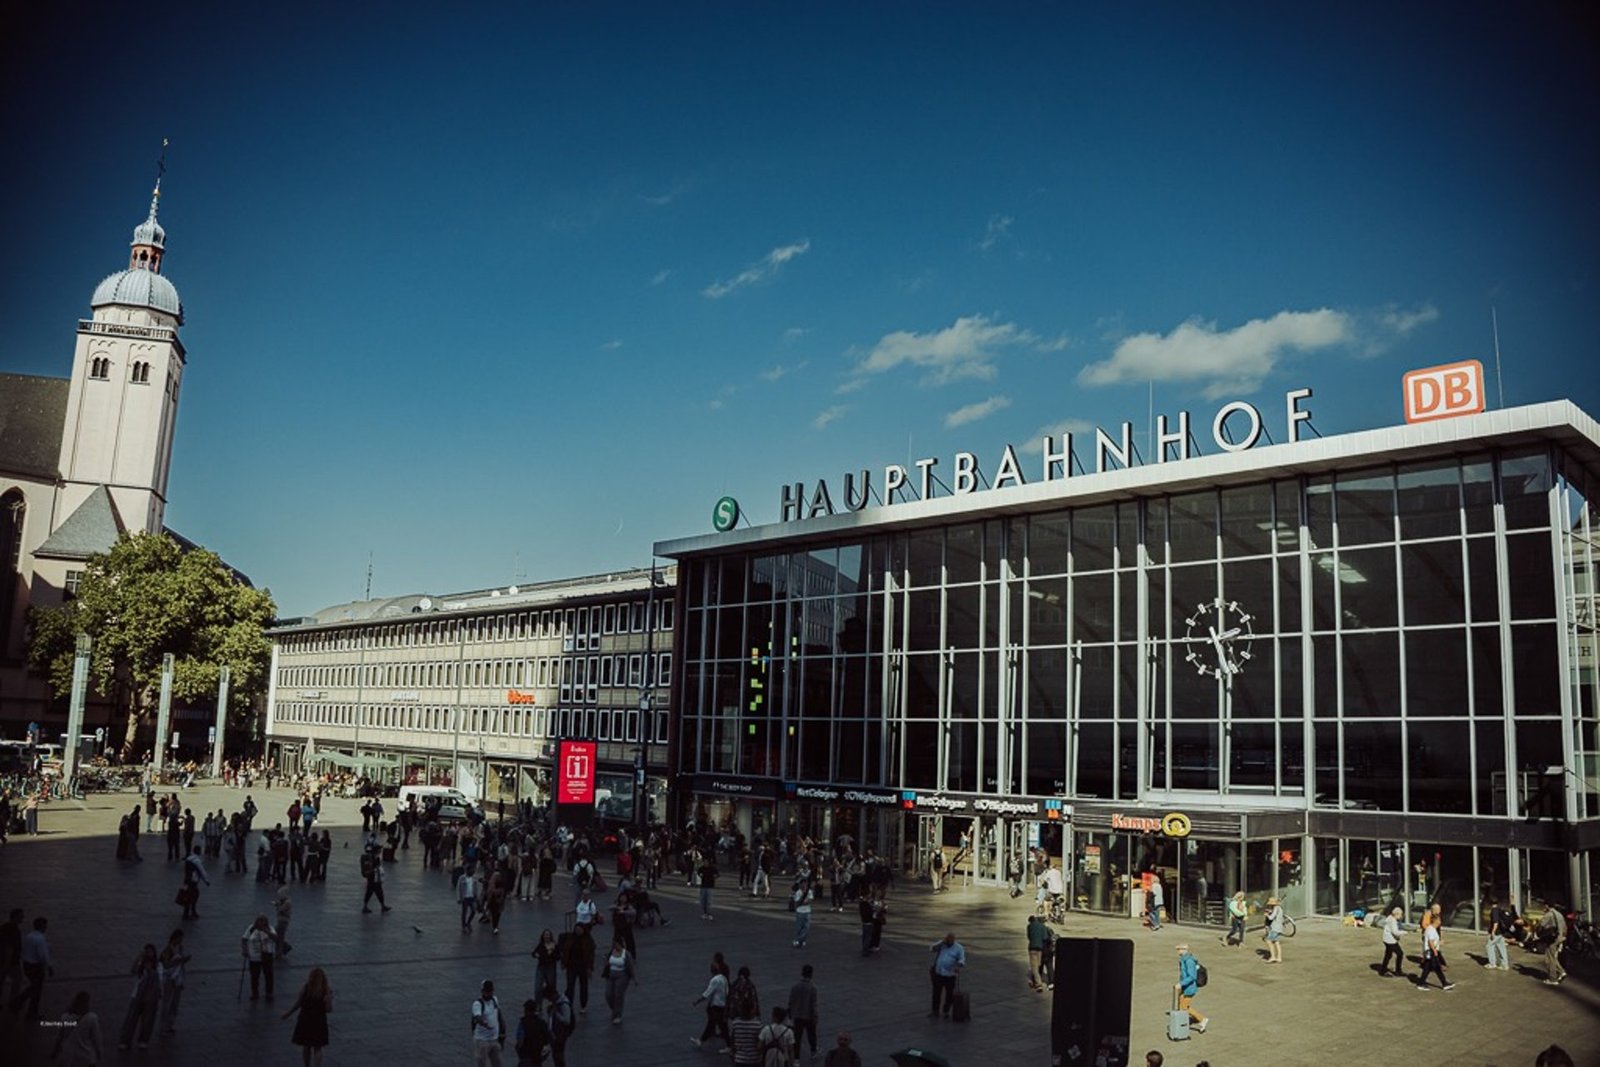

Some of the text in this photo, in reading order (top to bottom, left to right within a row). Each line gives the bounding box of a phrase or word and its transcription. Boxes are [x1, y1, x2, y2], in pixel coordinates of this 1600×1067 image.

[1412, 370, 1474, 416] DB
[780, 387, 1313, 522] HAUPTBAHNHOF
[716, 501, 732, 529] S
[1111, 813, 1162, 833] Kamps
